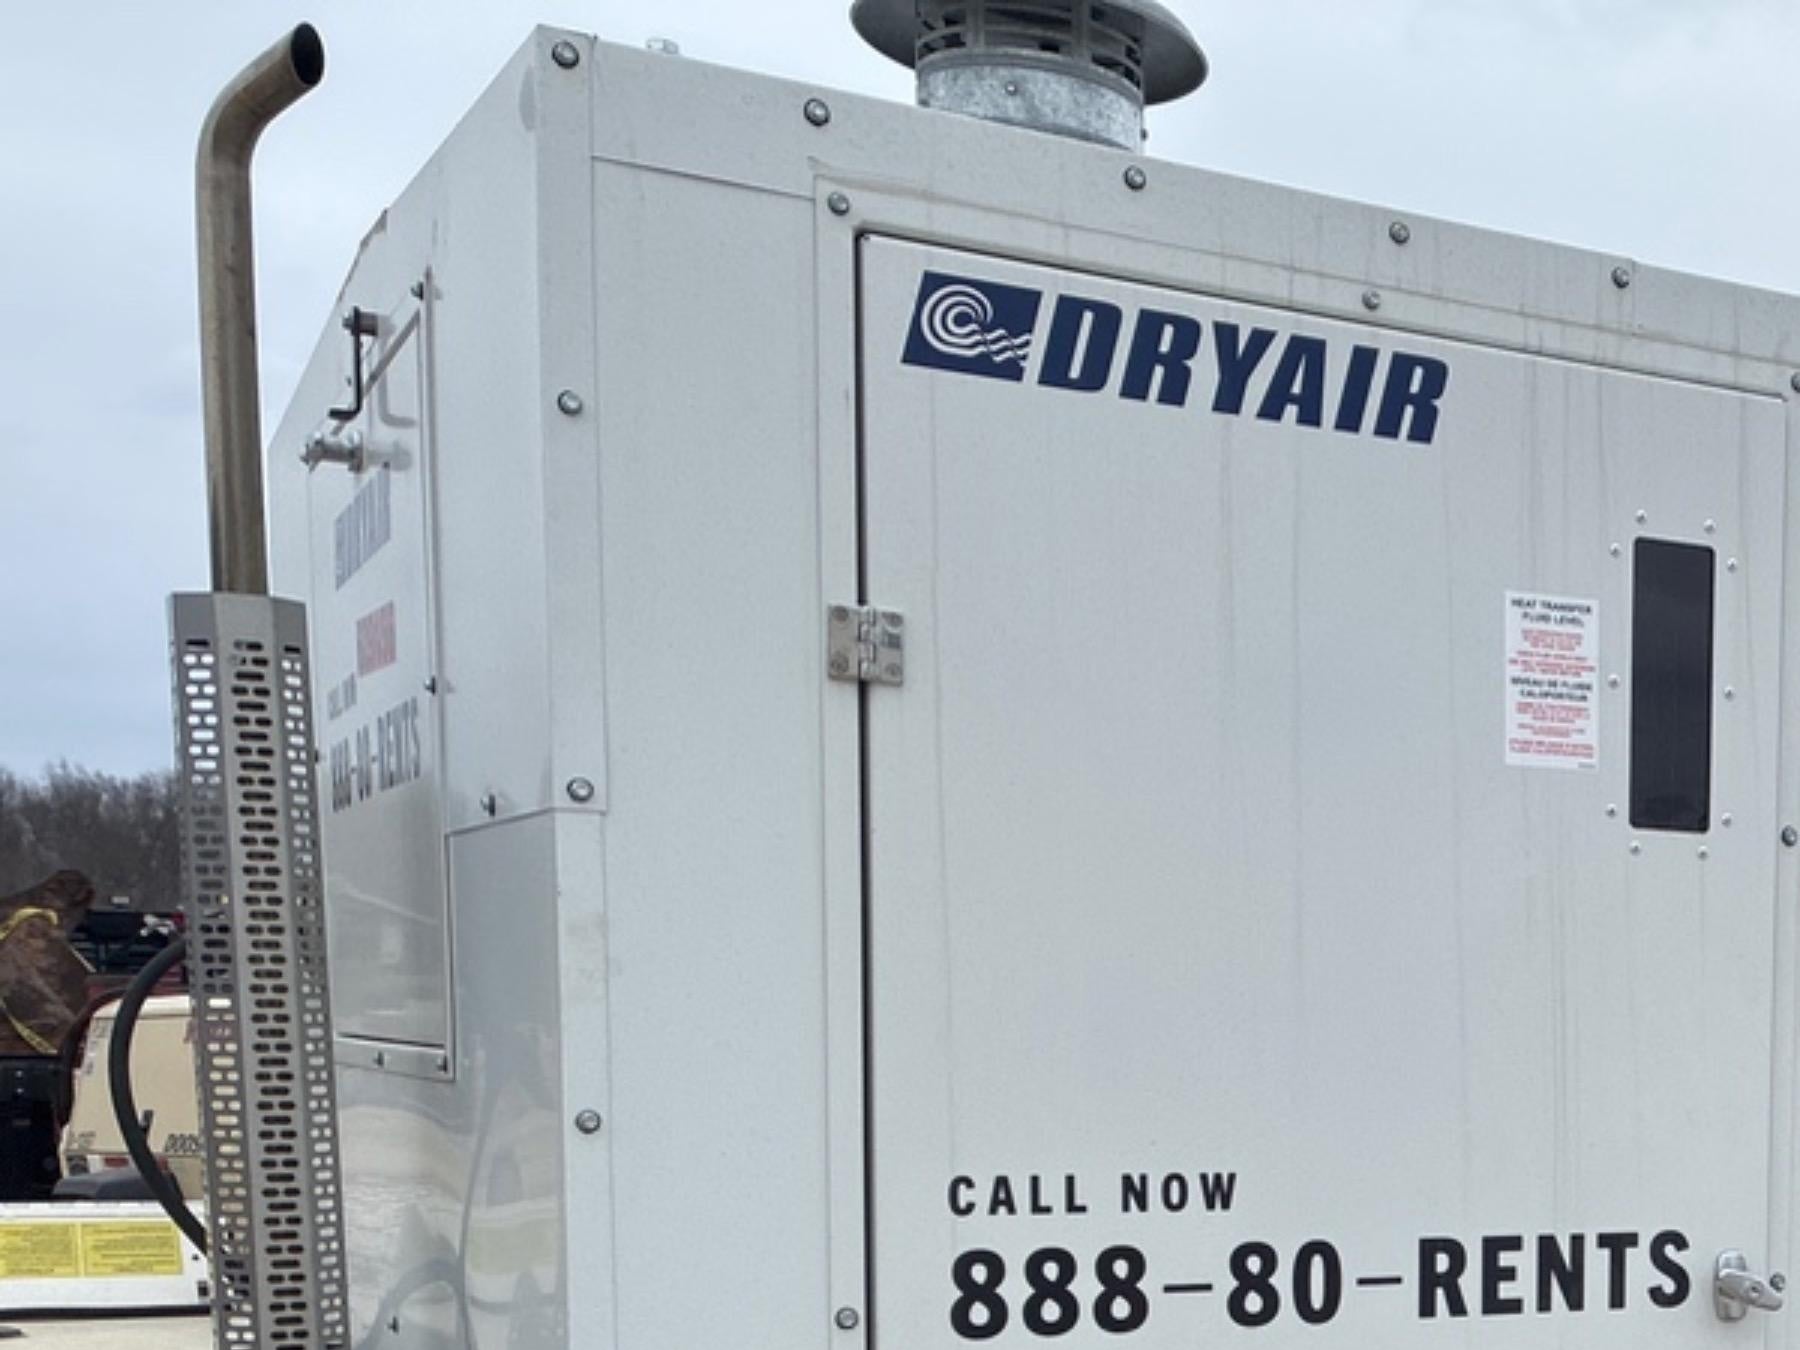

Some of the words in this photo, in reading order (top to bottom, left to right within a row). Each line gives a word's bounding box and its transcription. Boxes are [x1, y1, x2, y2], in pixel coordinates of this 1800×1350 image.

[1037, 293, 1449, 445] DRYAIR
[948, 1174, 1088, 1216] CALL
[1121, 1172, 1238, 1213] NOW
[949, 1230, 1692, 1340] 888-80-RENTS
